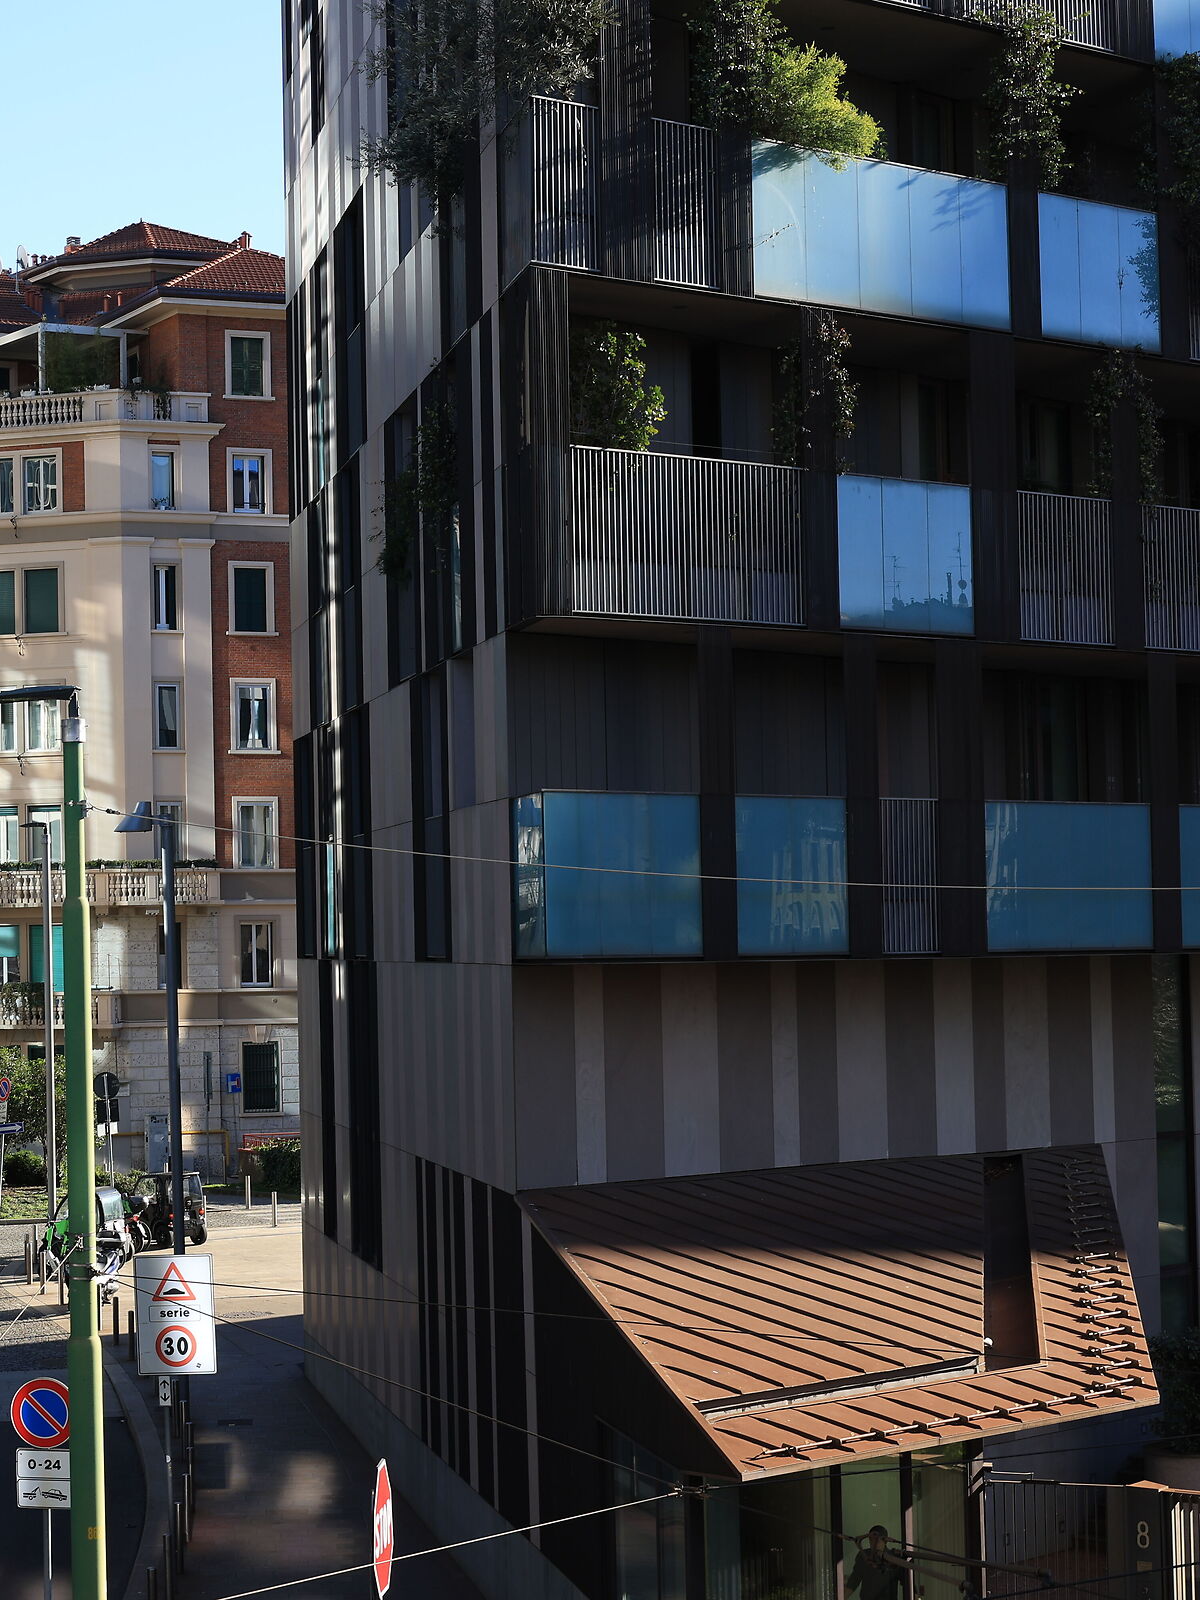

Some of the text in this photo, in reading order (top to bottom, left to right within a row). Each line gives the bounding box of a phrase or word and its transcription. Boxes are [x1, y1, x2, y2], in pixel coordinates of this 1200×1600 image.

[160, 1308, 190, 1317] serie
[163, 1336, 188, 1356] 30
[28, 1459, 61, 1470] 0-24
[1136, 1520, 1150, 1549] 8
